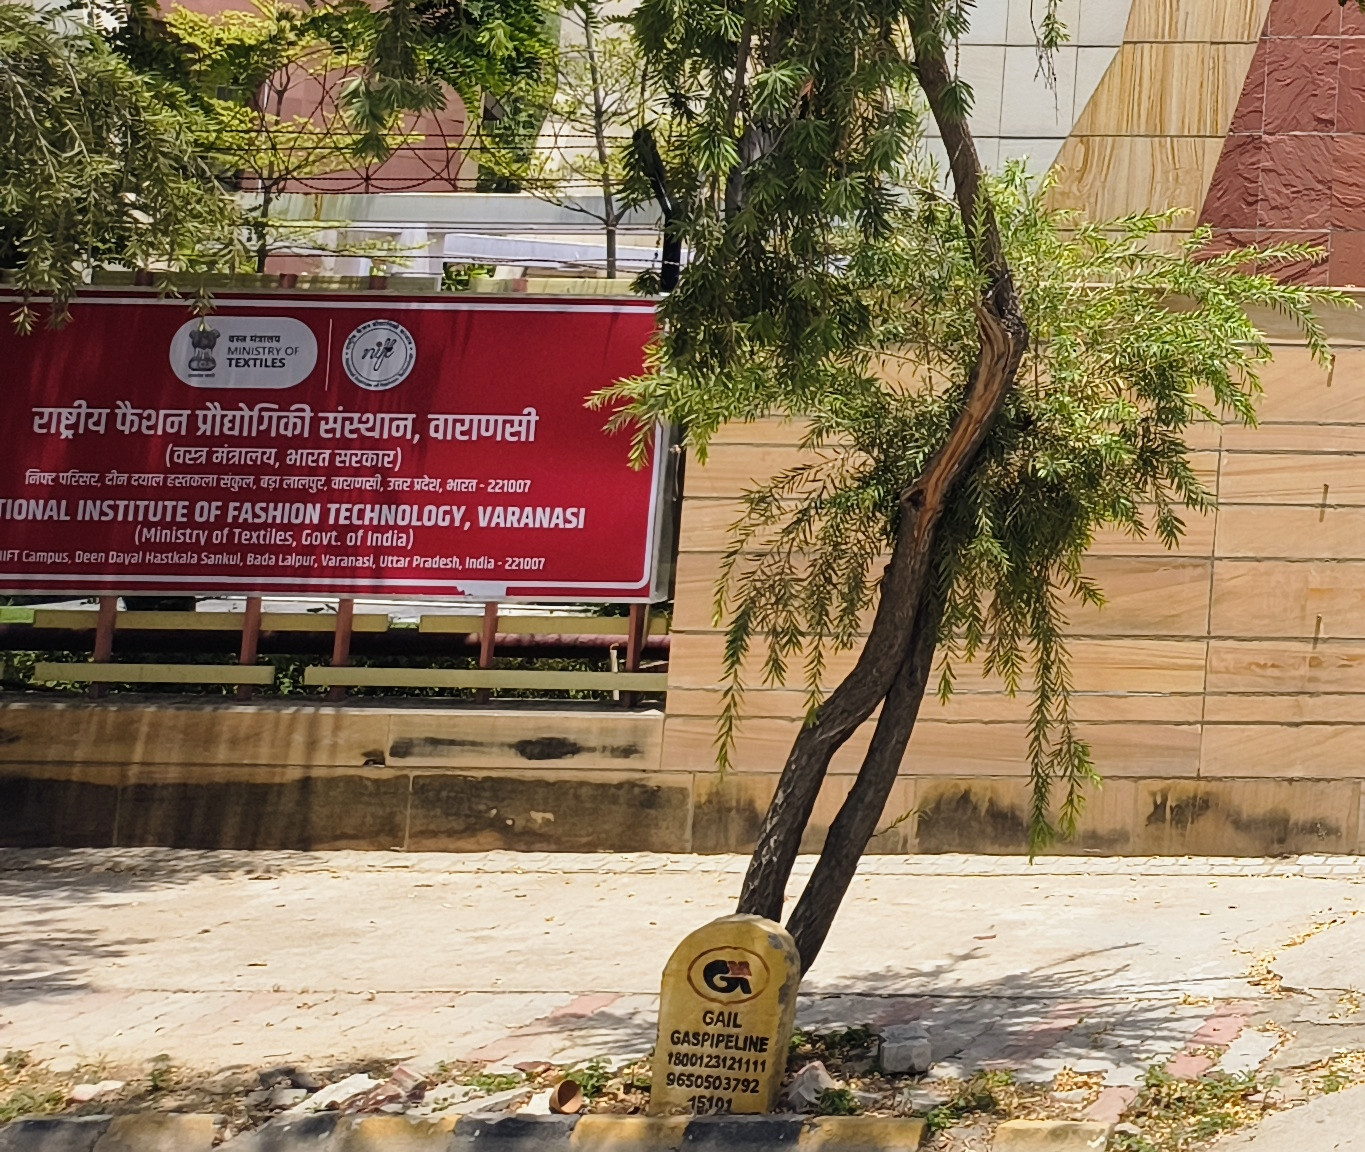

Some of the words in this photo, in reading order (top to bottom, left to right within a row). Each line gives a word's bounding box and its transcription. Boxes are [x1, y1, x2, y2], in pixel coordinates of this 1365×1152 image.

[227, 346, 282, 356] MINISTRY
[284, 346, 300, 356] OF
[226, 357, 286, 368] TEXTILES
[32, 399, 111, 439] राष्ट्रीय
[115, 400, 191, 436] फैशन
[195, 401, 314, 437] प्रौद्योगिकी
[318, 405, 421, 445] संस्थान,
[427, 407, 540, 443] वाराणसी
[165, 443, 209, 468] (वस्त्र
[212, 444, 280, 469] मंत्रालय,
[286, 448, 332, 468] भारत
[334, 447, 402, 472] सरकार)
[105, 469, 128, 486] दीन
[130, 472, 165, 487] दयाल
[166, 473, 218, 489] हस्तकला
[220, 472, 257, 492] संकुल,
[282, 476, 328, 494] लालपुर,
[331, 474, 384, 493] वाराणसी,
[386, 477, 412, 491] उत्तर
[413, 475, 443, 494] प्रदेश,
[446, 478, 478, 493] भारत
[487, 478, 532, 494] 221007
[77, 499, 190, 523] INSTITUTE
[194, 501, 222, 523] OF
[227, 501, 321, 525] FASHION
[327, 503, 471, 531] TECHNOLOGY,
[477, 505, 586, 529] VARANASI
[134, 524, 208, 546] (Ministry
[212, 526, 229, 544] of
[233, 527, 297, 547] Textiles,
[302, 529, 341, 547] Govt.
[346, 529, 365, 546] of
[367, 528, 414, 550] India)
[22, 550, 72, 565] Campus,
[75, 550, 105, 563] Deen
[108, 551, 142, 566] Dayal
[146, 551, 198, 565] Hastkala
[200, 552, 244, 567] Sankul,
[247, 553, 276, 566] Bada
[278, 553, 318, 569] Lalpur,
[321, 553, 375, 569] Varanasi,
[379, 555, 409, 568] Uttar
[412, 555, 462, 571] Pradesh,
[465, 556, 495, 569] India
[505, 557, 545, 571] 221007
[702, 1010, 742, 1028] GAIL
[670, 1030, 769, 1053] GASPIPELINE
[667, 1052, 766, 1073] 1800123121111
[666, 1072, 760, 1094] 9650503792
